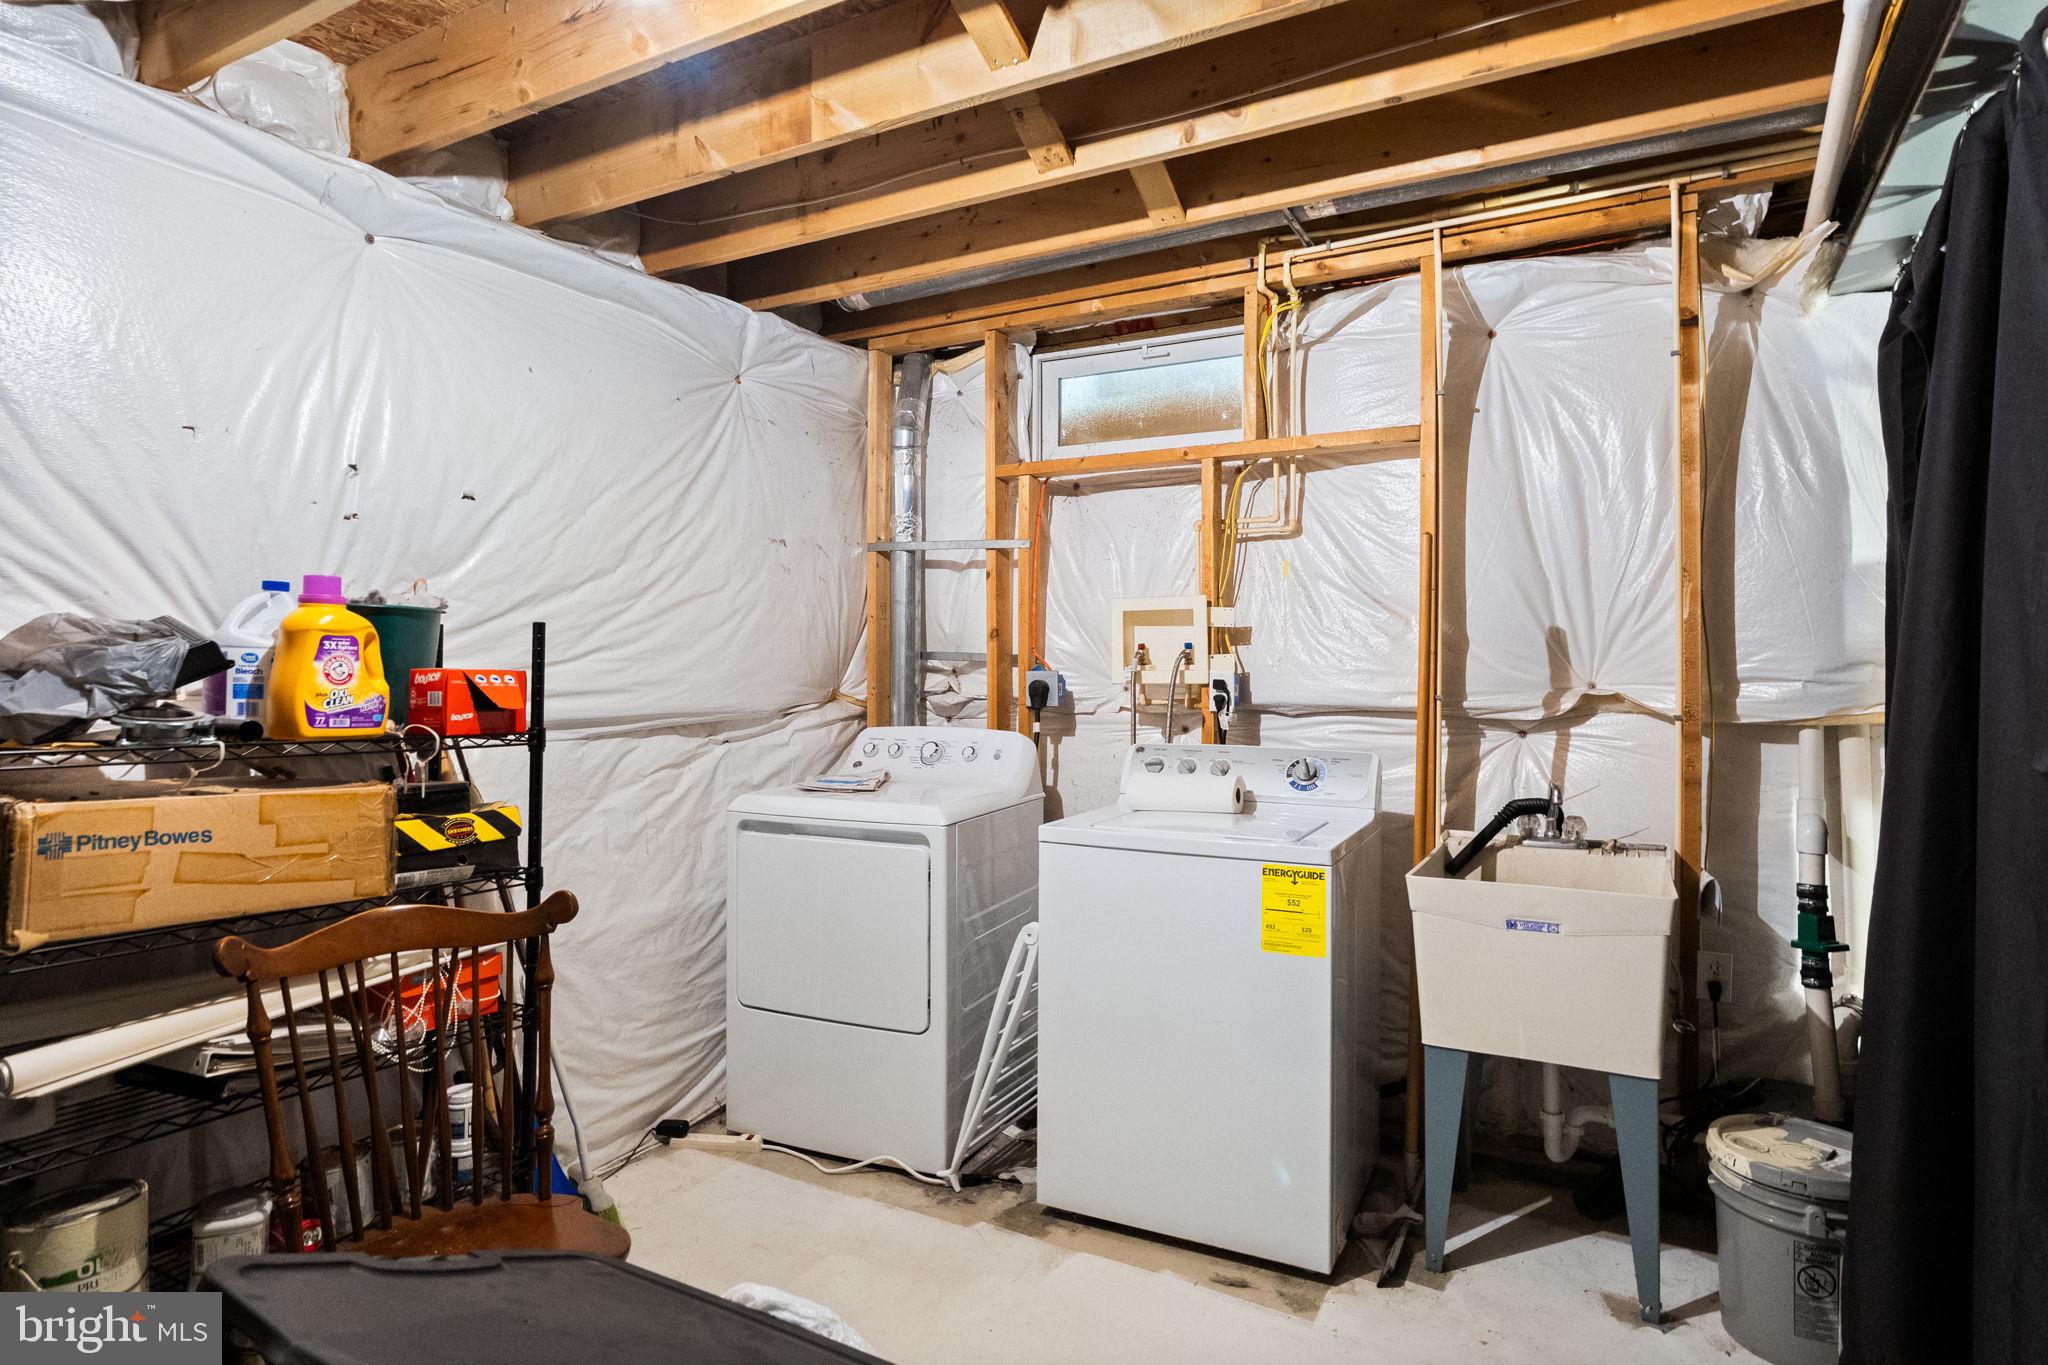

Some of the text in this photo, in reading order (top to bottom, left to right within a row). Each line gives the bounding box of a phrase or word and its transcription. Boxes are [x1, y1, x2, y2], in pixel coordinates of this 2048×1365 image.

[323, 640, 338, 650] 3X
[235, 667, 263, 675] Bleach
[414, 671, 442, 685] bounce
[329, 688, 348, 699] OXI
[322, 695, 354, 710] CLEAN
[314, 716, 327, 725] 77
[450, 712, 474, 721] bounce
[76, 829, 213, 852] Pitney Bowes
[1287, 898, 1301, 907] $52
